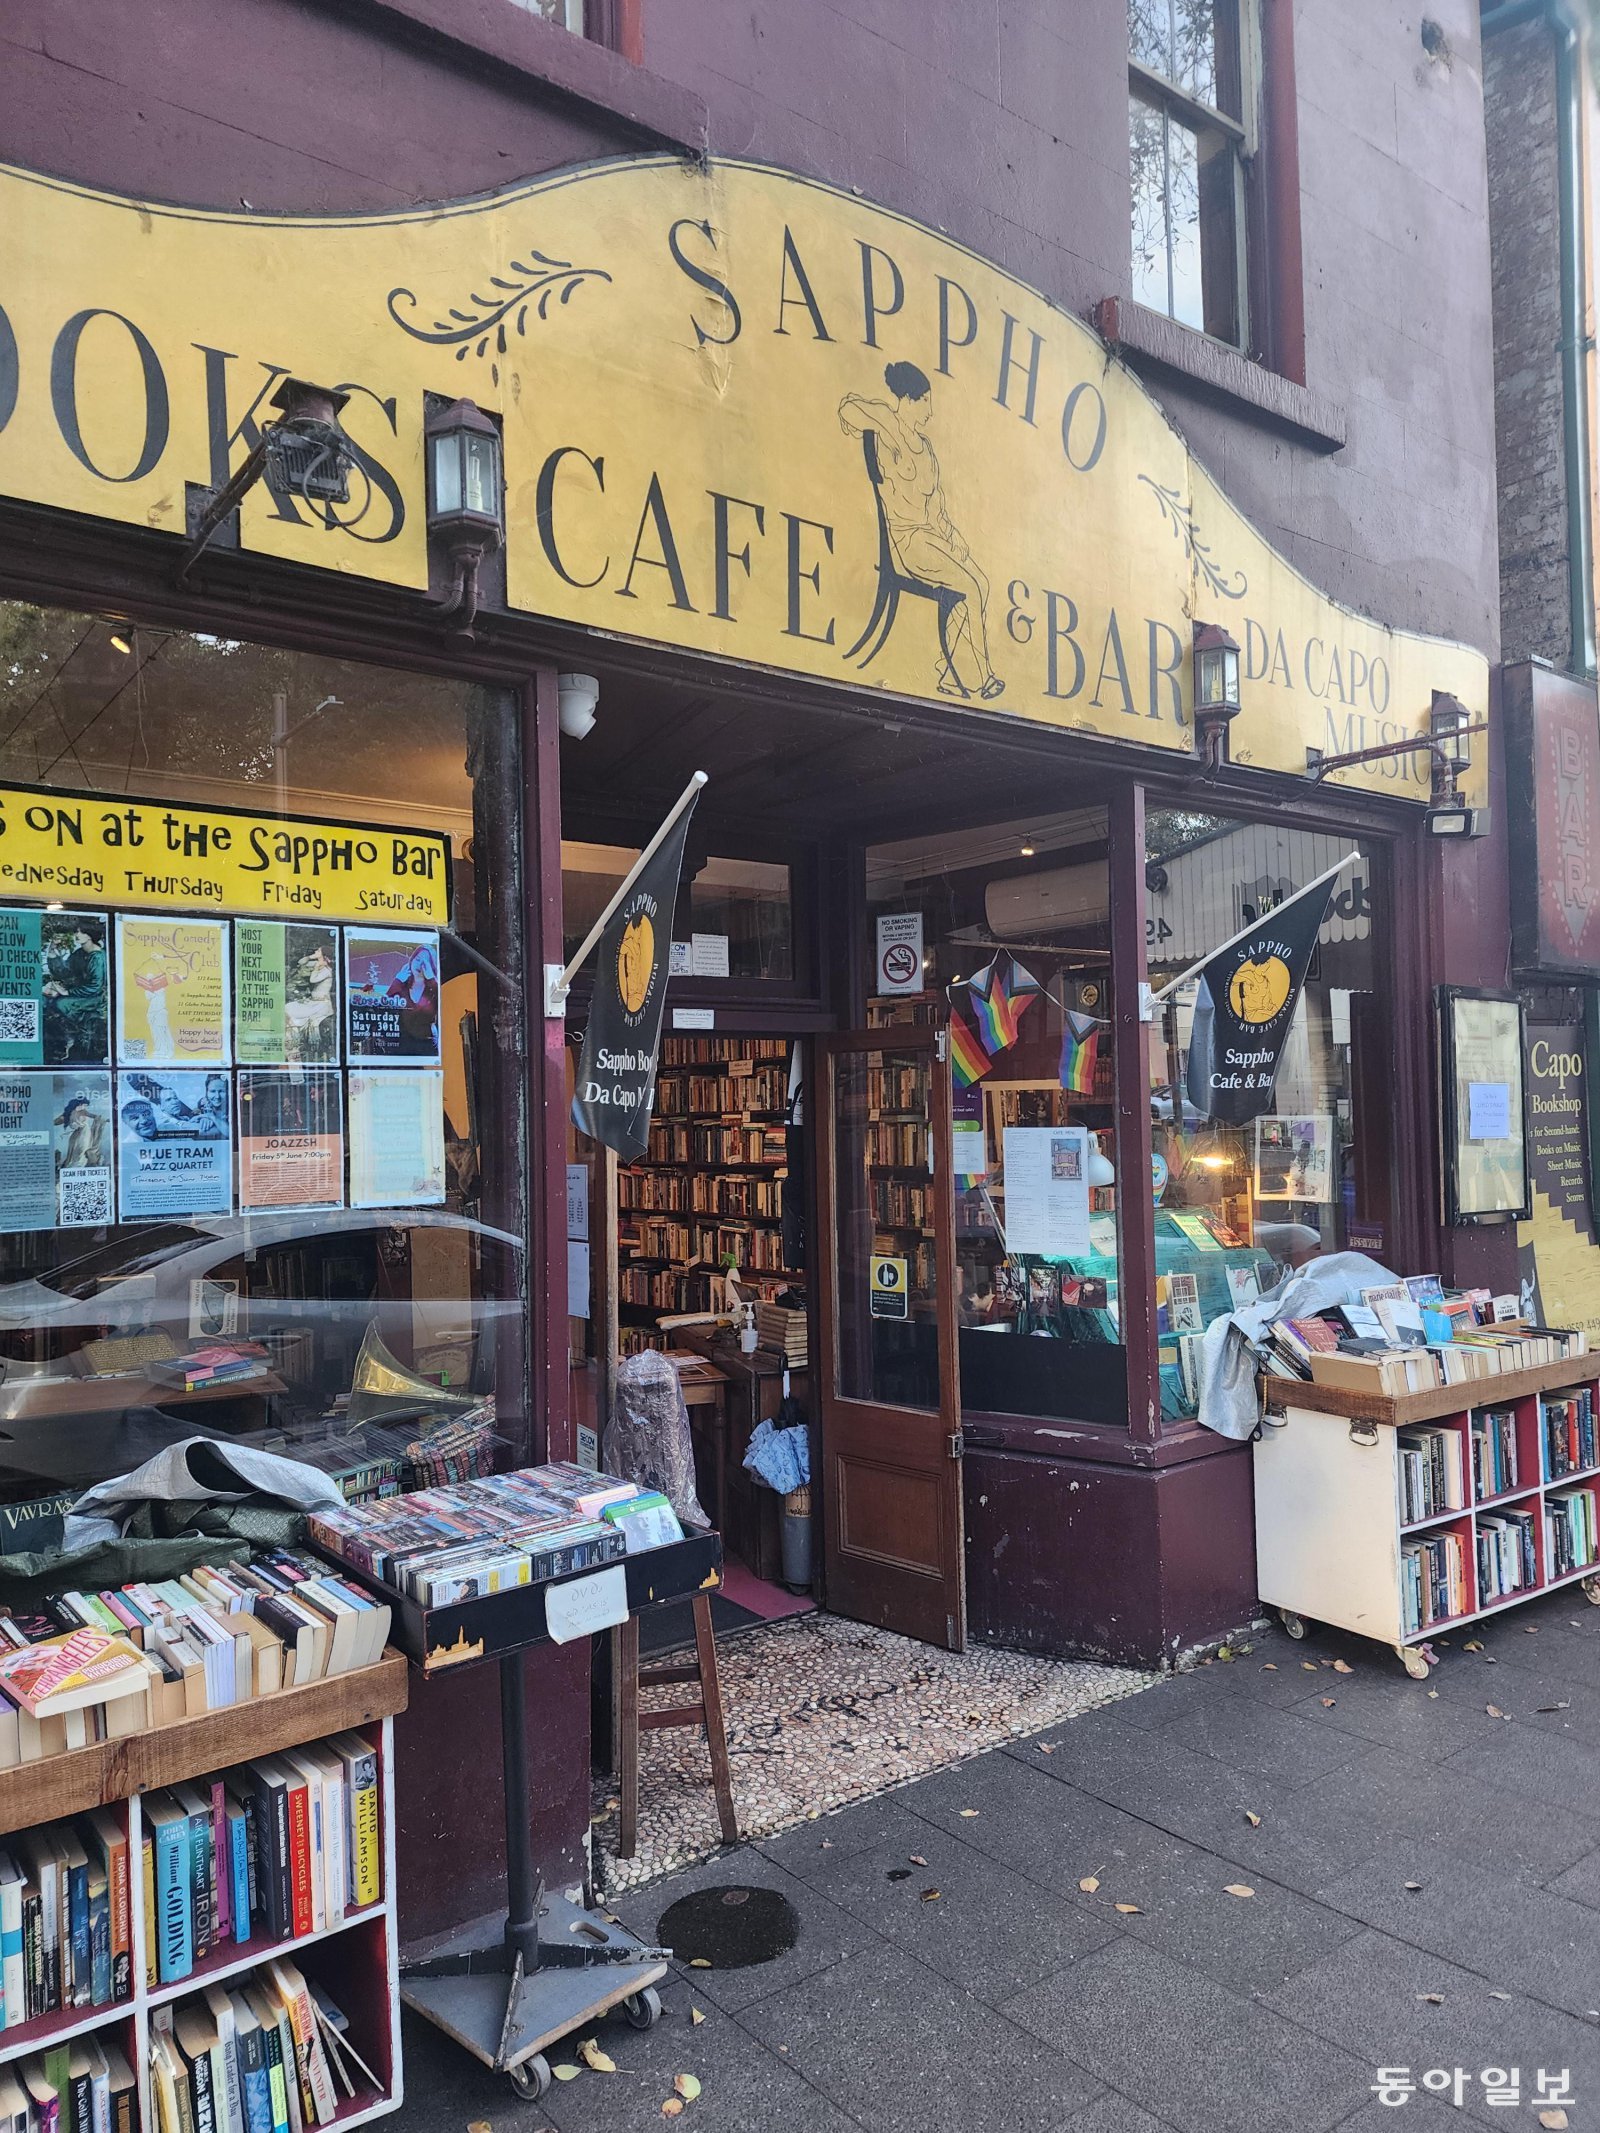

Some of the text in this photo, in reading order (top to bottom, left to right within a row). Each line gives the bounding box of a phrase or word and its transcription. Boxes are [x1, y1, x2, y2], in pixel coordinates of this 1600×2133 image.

[669, 219, 1108, 472] SAPPHO
[0, 306, 405, 544] OKS
[536, 446, 1189, 727] CAFE & BAR
[1242, 617, 1391, 714] DA CAPO
[1558, 725, 1588, 909] BAR
[24, 806, 84, 847] ON
[100, 808, 144, 847] at
[392, 839, 441, 880] Bar
[263, 880, 322, 910] Friday
[624, 892, 658, 925] SAPPHO
[0, 916, 18, 930] CAN
[891, 917, 918, 926] SMOKING
[894, 923, 915, 931] VAPING
[0, 933, 26, 947] ELOW
[124, 922, 216, 951] Sappho Comedy
[241, 929, 262, 941] HOST
[241, 942, 262, 955] YOUR
[1237, 940, 1292, 962] SAPPHO
[8, 950, 41, 964] CHECK
[189, 951, 220, 972] Club
[241, 956, 262, 968] NEXT
[0, 966, 36, 980] UT OUR
[241, 969, 281, 983] FUNCTION
[0, 982, 32, 996] VENTS
[241, 983, 269, 996] AT THE
[241, 997, 274, 1009] SAPPHO
[241, 1010, 261, 1022] BAR!
[352, 1010, 400, 1023] Saturday
[179, 1028, 219, 1036] Happy hour
[352, 1021, 400, 1032] May 30th
[1238, 1022, 1255, 1034] BAR
[596, 1047, 636, 1077] Sappho
[1225, 1047, 1274, 1069] Sappho
[1531, 1040, 1582, 1090] Capo
[1209, 1072, 1243, 1089] Cafe
[1244, 1073, 1256, 1089] &
[0, 1086, 31, 1099] APPHO
[582, 1081, 610, 1105] Da
[612, 1084, 636, 1113] Capo
[0, 1101, 30, 1114] OETRY
[1531, 1093, 1582, 1118] Bookshop
[0, 1115, 23, 1129] IGHT
[1534, 1126, 1543, 1137] for
[265, 1138, 317, 1149] JOAZZSH
[1536, 1145, 1554, 1156] Books
[1563, 1142, 1581, 1152] Music
[140, 1147, 214, 1160] BLUE TRAM
[252, 1153, 275, 1161] Friday
[140, 1160, 213, 1171] JAZZ QUARTET
[1547, 1159, 1582, 1171] Sheet Music
[86, 1169, 107, 1177] TICKETS
[1560, 1175, 1583, 1187] Records
[1566, 1192, 1585, 1203] Scores
[1368, 1293, 1383, 1302] marie
[29, 1628, 112, 1700] TEHRANGELES
[368, 1790, 377, 1834] DAVID
[295, 1794, 306, 1892] SWEENEY BICYCLES
[358, 1794, 369, 1885] WILLIAMSON
[194, 1818, 210, 1946] AIKI FLINTHART IRON
[118, 1856, 129, 1942] FIONA O'LOUGHLIN
[166, 1845, 185, 1966] William GOLDING
[35, 1945, 43, 1985] YESTERDAY
[223, 2041, 235, 2060] Gang
[195, 2056, 206, 2094] HIGSON
[225, 2061, 236, 2083] Leader
[227, 2085, 236, 2095] for
[76, 2080, 88, 2118] The Cold
[179, 2084, 188, 2112] ANNIE
[229, 2102, 238, 2117] Day
